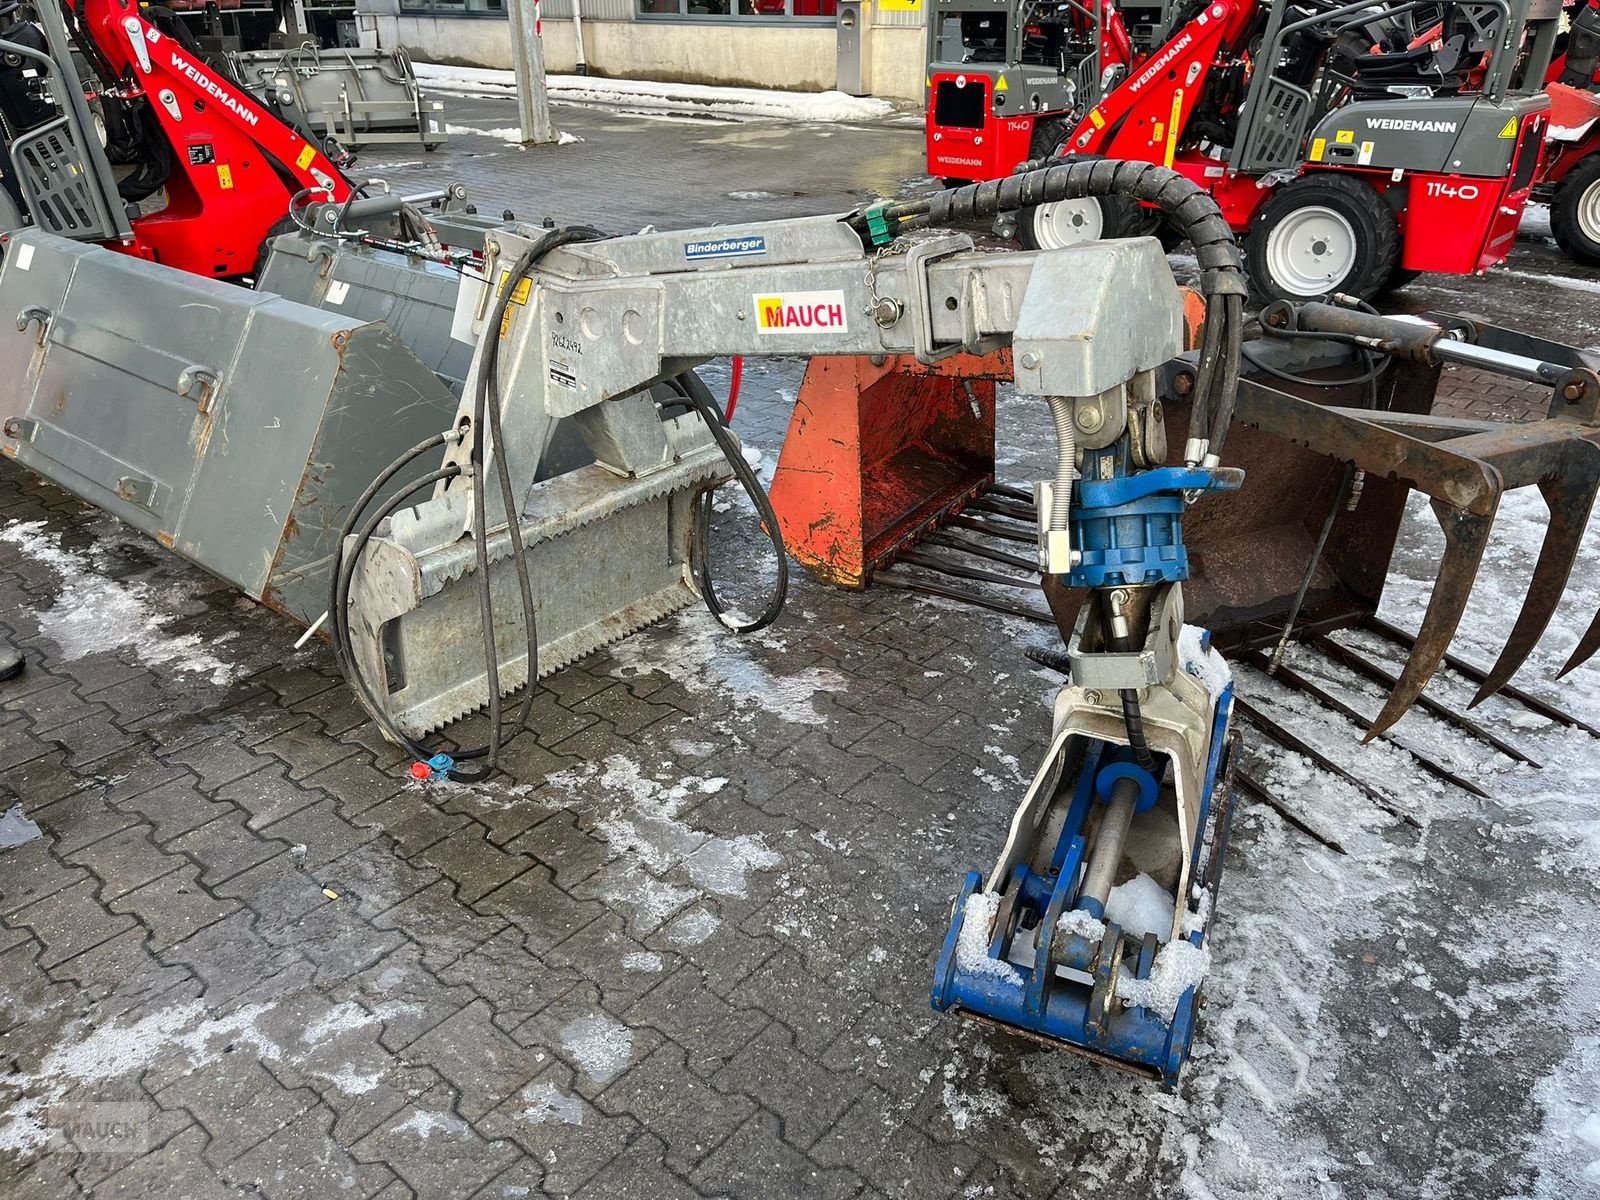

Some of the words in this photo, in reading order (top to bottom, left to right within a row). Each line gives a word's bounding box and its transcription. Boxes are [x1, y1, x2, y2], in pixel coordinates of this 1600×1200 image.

[1129, 33, 1193, 93] WEIDEMANN
[171, 52, 259, 127] WEIDEMANN
[1026, 77, 1058, 86] WEIDEMANN
[1007, 121, 1030, 132] 1140
[1366, 117, 1457, 134] WEIDEMANN
[937, 155, 982, 167] WEIDEMANN
[1427, 182, 1479, 199] 1140
[686, 237, 763, 255] Binderberger
[765, 304, 843, 329] MAUCH
